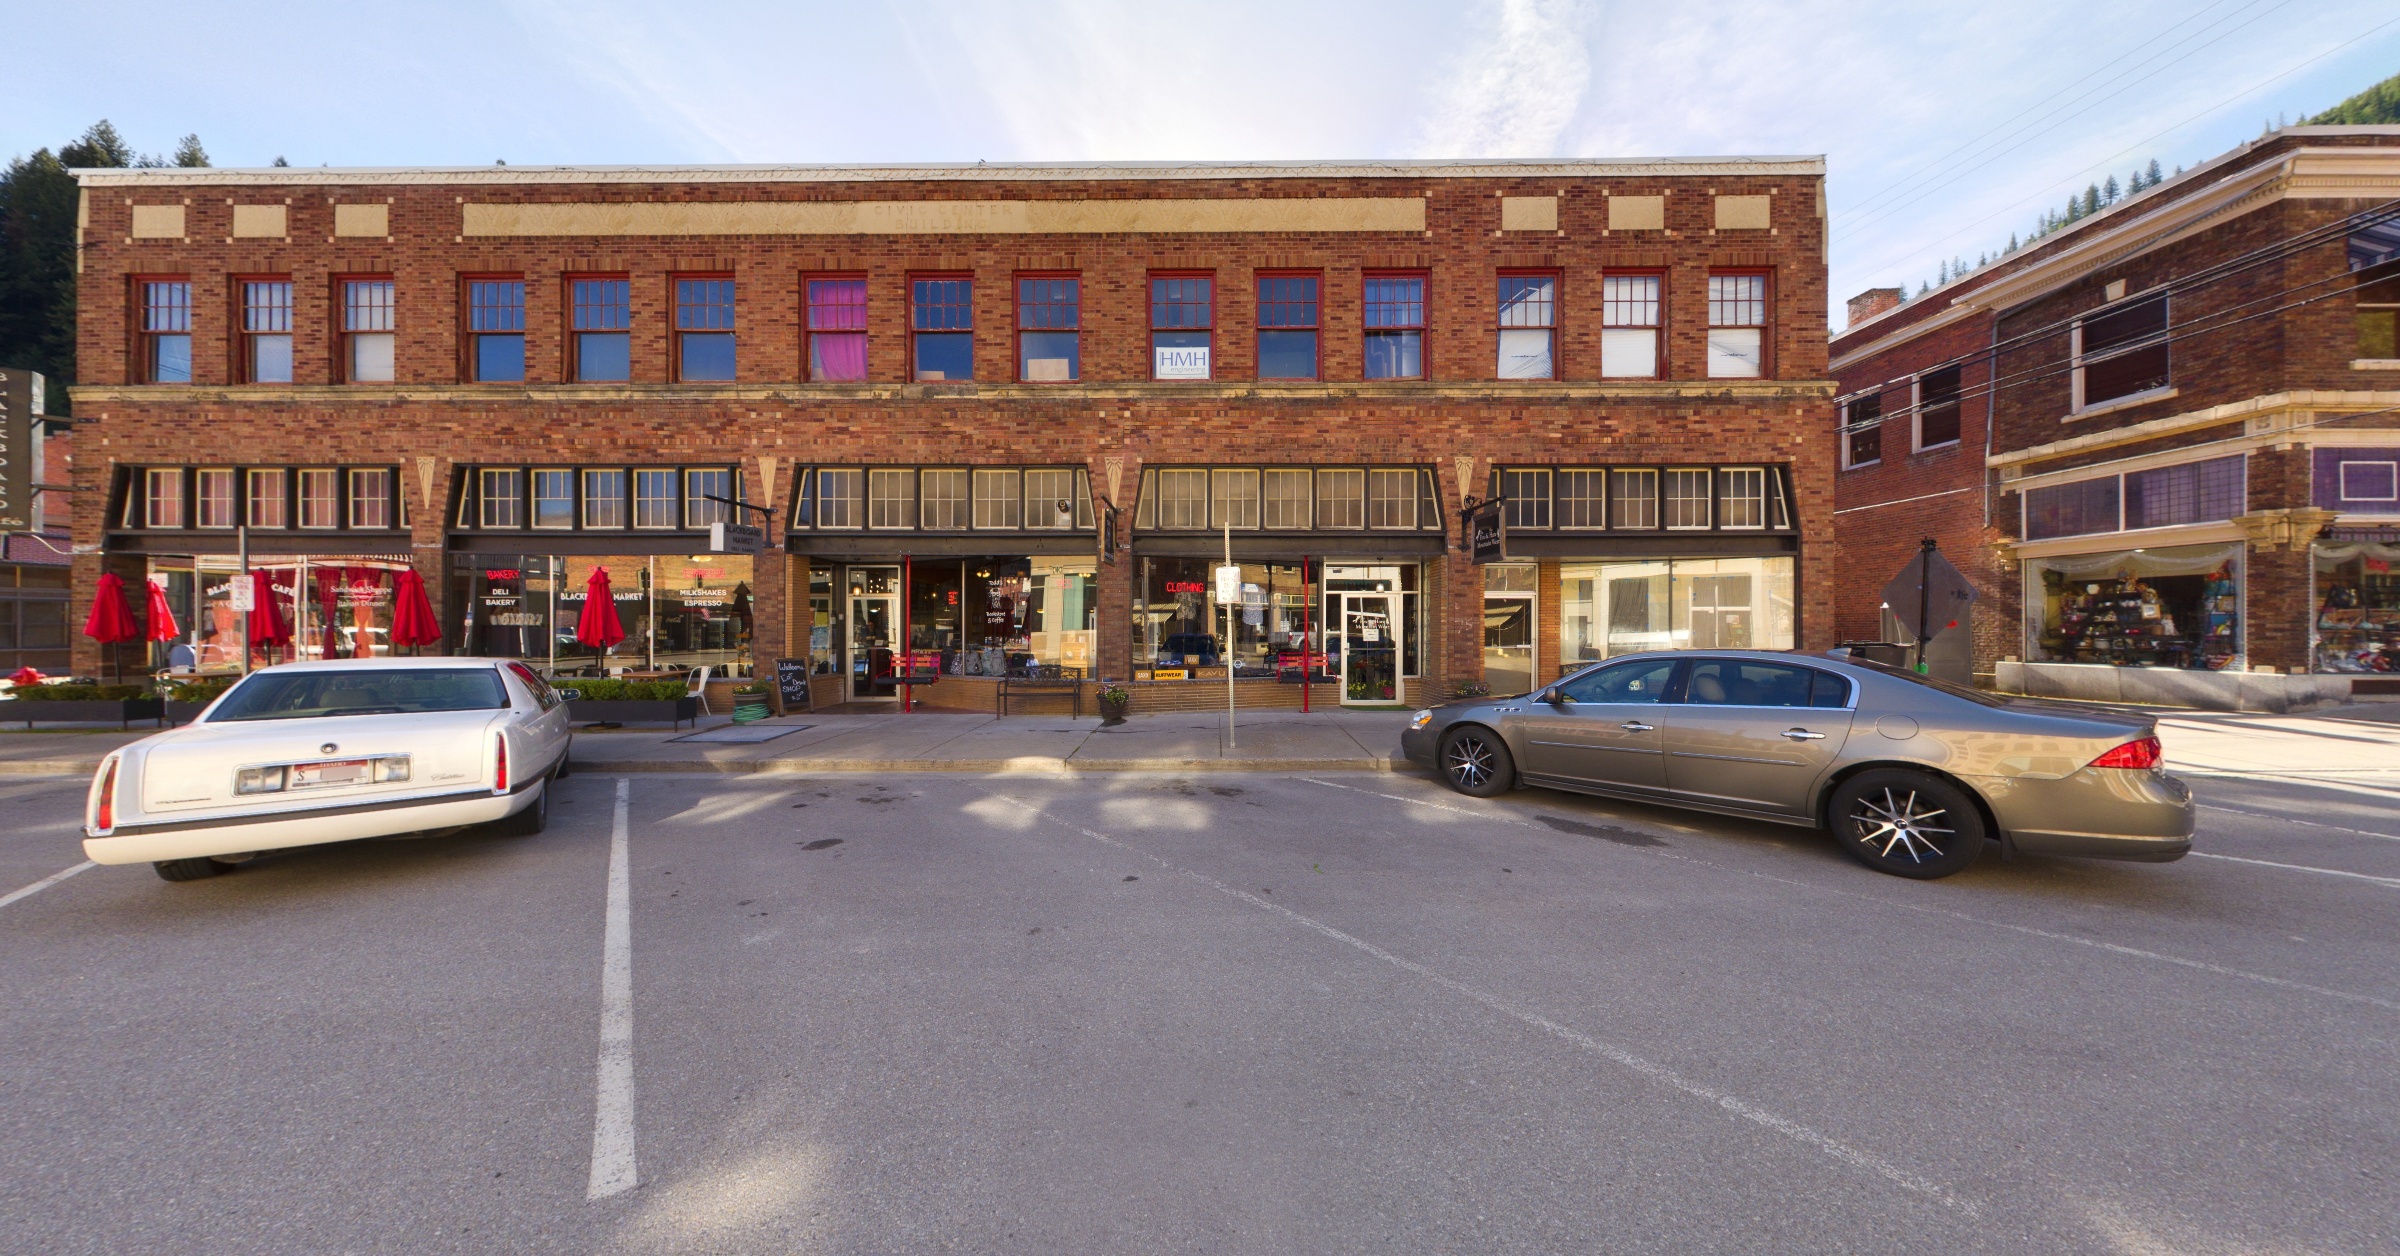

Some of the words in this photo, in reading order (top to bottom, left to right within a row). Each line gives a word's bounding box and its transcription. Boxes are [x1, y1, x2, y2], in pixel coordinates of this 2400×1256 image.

[1161, 351, 1206, 367] HMH
[1170, 366, 1206, 374] engineering
[725, 524, 761, 537] BLACKBOARD
[732, 536, 754, 545] MARKET
[486, 570, 520, 580] BAKERY
[1165, 582, 1205, 592] CLOTHING
[613, 592, 643, 601] MARKET
[780, 672, 793, 682] Eat
[298, 770, 305, 781] S
